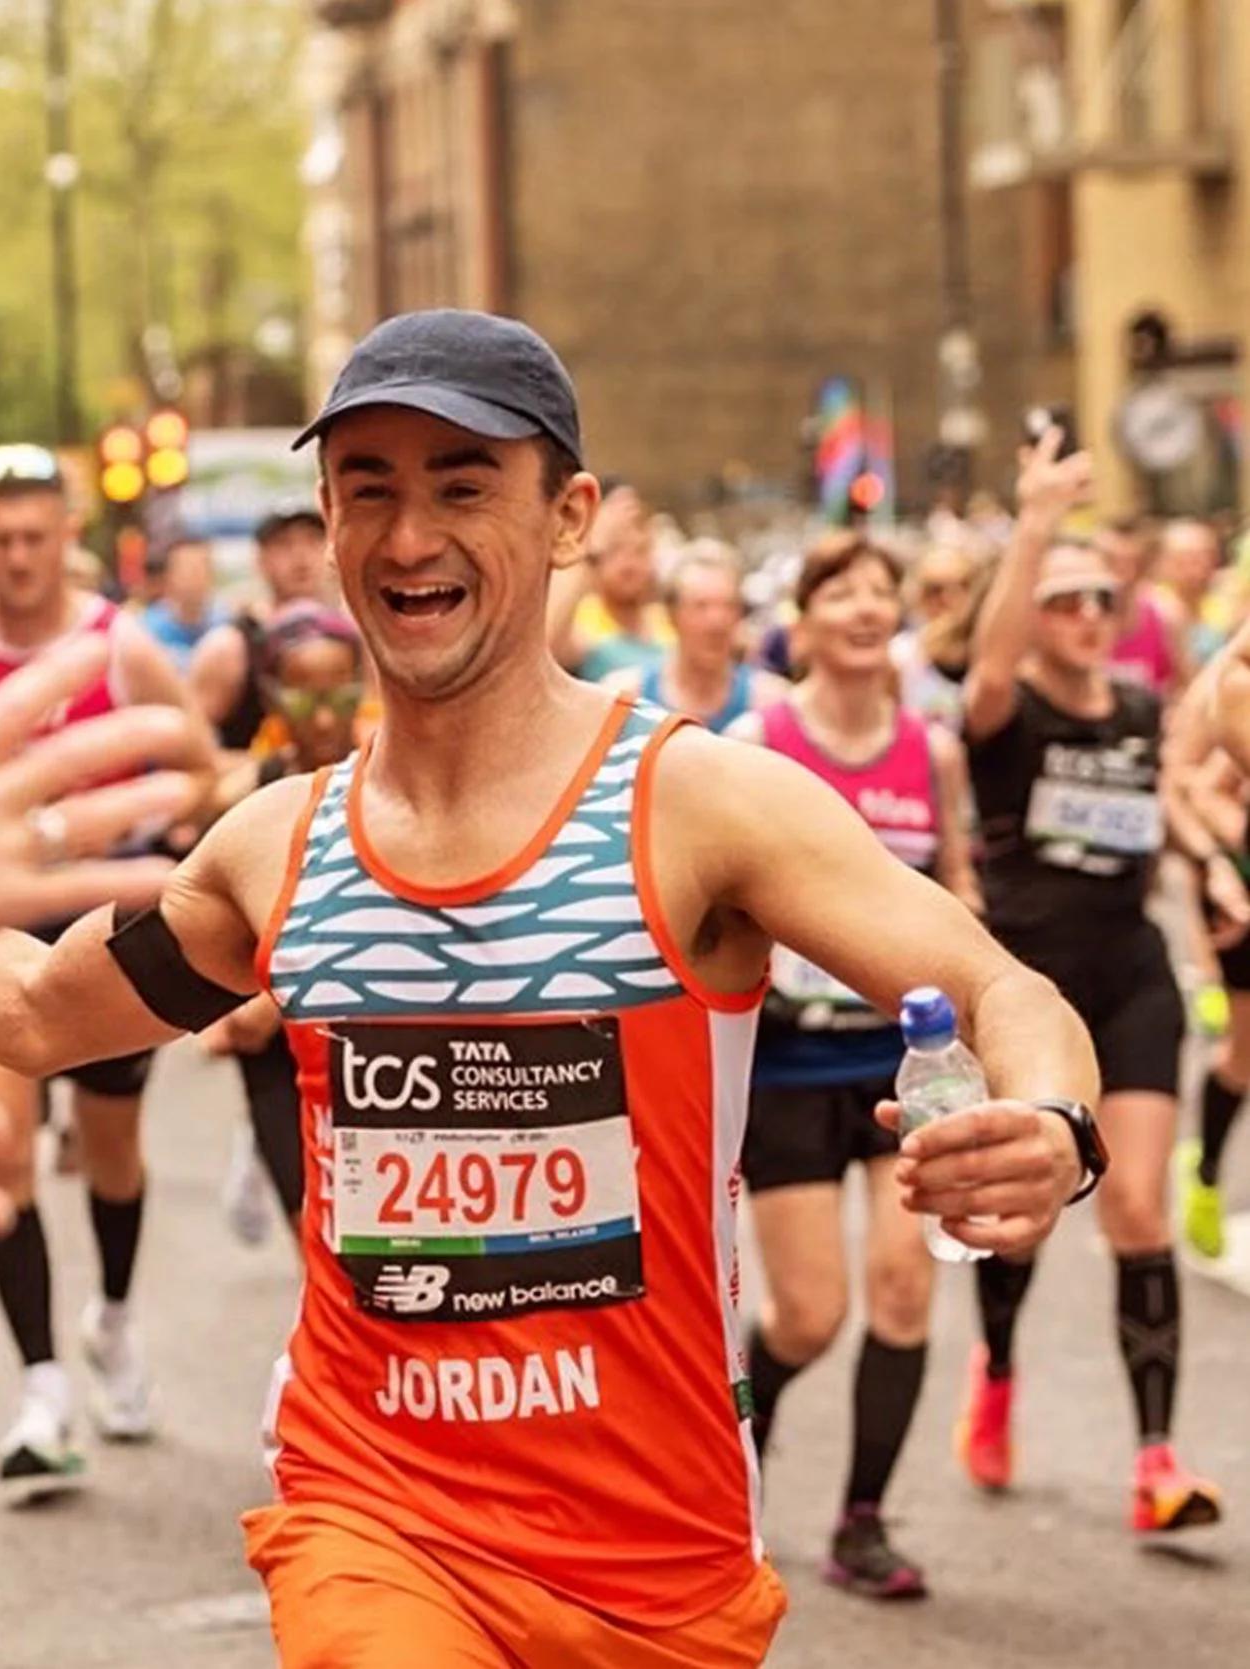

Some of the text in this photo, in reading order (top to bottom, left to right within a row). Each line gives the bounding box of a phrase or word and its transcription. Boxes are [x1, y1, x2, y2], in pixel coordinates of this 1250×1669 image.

[449, 1041, 512, 1063] TATA
[342, 1041, 441, 1111] tcs
[451, 1059, 604, 1087] CONSULTANCY
[453, 1090, 550, 1112] SERVICES
[375, 1147, 587, 1225] 24979
[453, 1275, 618, 1313] new balance
[374, 1345, 600, 1423] JORDAN
